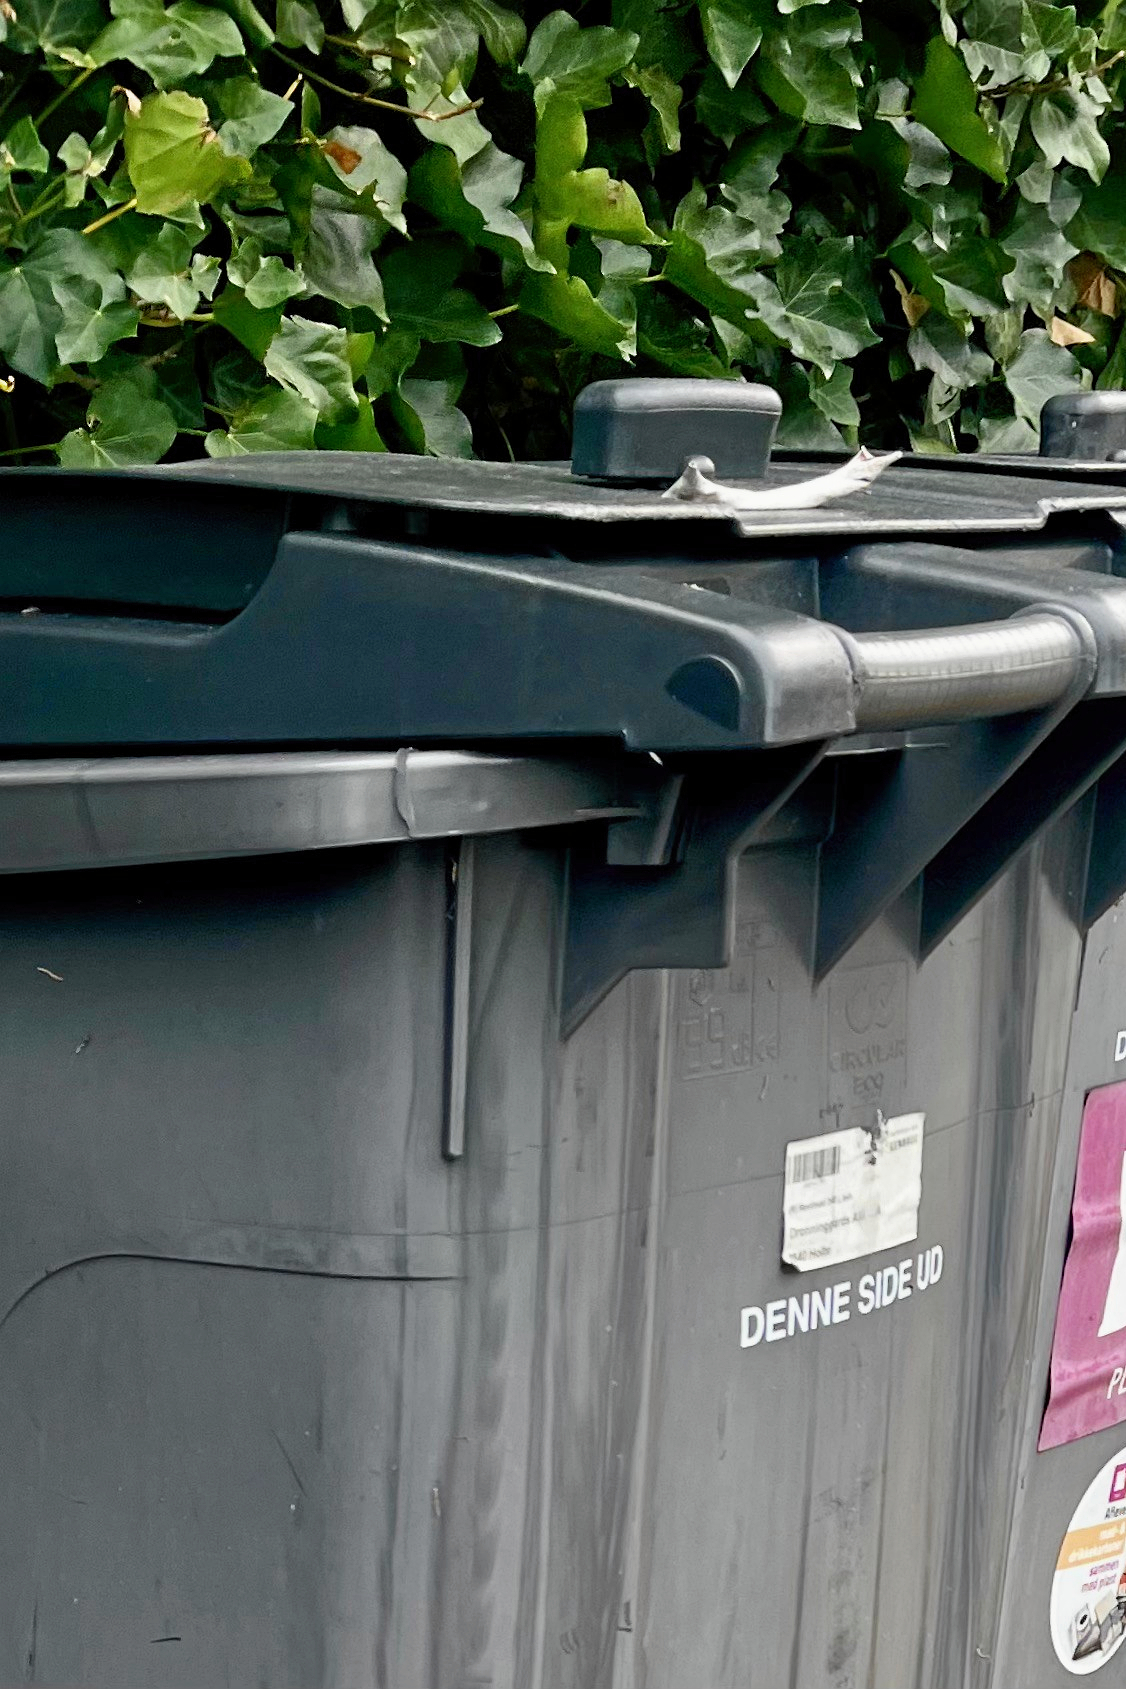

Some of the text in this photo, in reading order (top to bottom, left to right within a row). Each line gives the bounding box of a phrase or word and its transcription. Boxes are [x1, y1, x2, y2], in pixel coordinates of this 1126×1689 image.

[740, 1245, 943, 1348] DENNE SIDE UD
